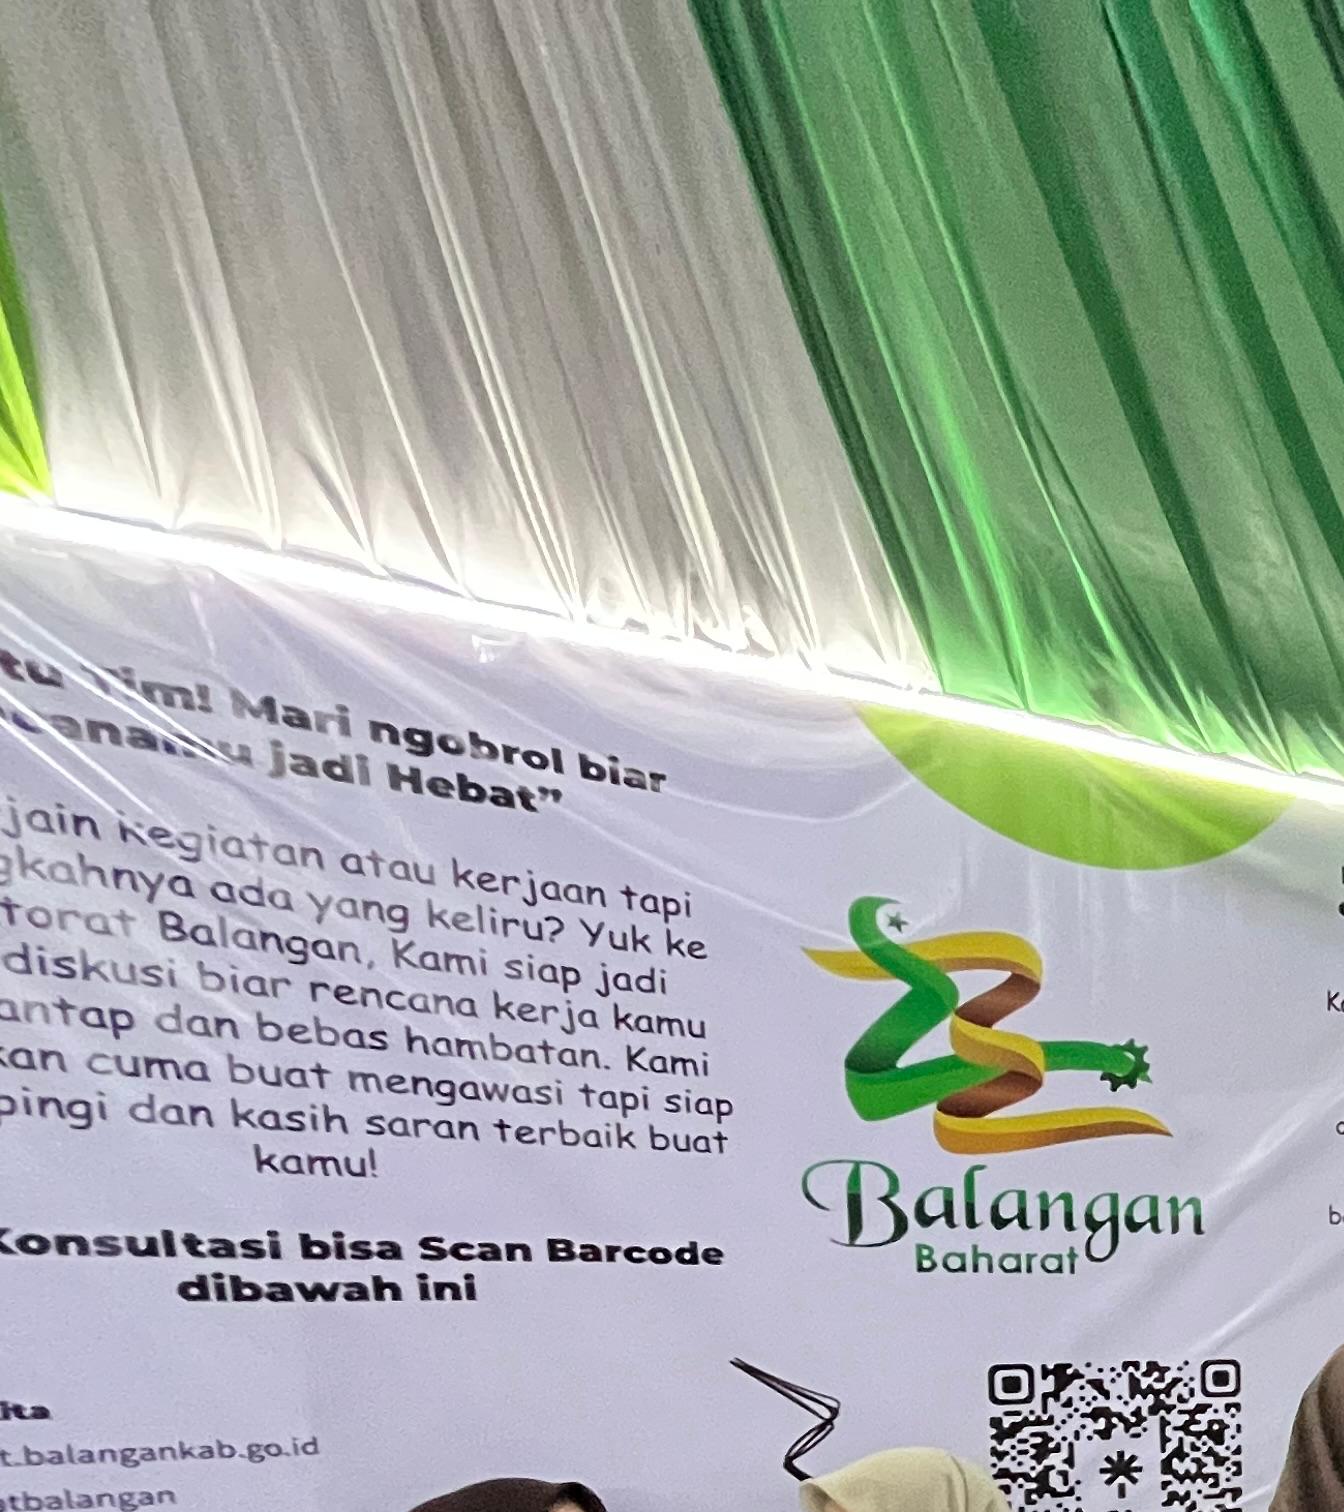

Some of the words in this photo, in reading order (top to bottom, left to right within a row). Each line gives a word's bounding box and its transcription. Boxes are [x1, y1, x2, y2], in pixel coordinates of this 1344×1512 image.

[0, 705, 253, 767] canamu
[268, 739, 371, 787] jadi
[228, 684, 353, 739] Mari
[368, 719, 565, 775] ngobrol
[578, 753, 668, 794] biar
[1, 796, 101, 840] jain
[341, 850, 434, 886] atau
[451, 859, 606, 908] kerjaan
[618, 882, 692, 923] tapi
[209, 879, 293, 912] ada
[308, 892, 410, 934] yang
[427, 896, 565, 945] keliru?
[580, 918, 652, 952] Yuk
[664, 929, 708, 961] ke
[3, 941, 177, 987] diskusi
[198, 961, 292, 999] biar
[309, 982, 479, 1019] rencana
[493, 996, 600, 1034] kerja
[612, 1006, 707, 1041] kamu
[392, 937, 488, 978] Kami
[503, 952, 582, 994] siap
[594, 960, 668, 998] jadi
[155, 1003, 240, 1041] dan
[257, 1012, 390, 1051] bebas
[405, 1026, 610, 1071] hambatan.
[626, 1044, 711, 1078] Kami
[87, 1053, 209, 1082] cuma
[228, 1055, 332, 1091] buat
[348, 1068, 564, 1106] mengawasi
[578, 1084, 651, 1117] tapi
[663, 1089, 733, 1125] siap
[129, 1094, 214, 1128] dan
[231, 1098, 348, 1137] kasih
[365, 1117, 480, 1142] saran
[494, 1119, 636, 1152] terbaik
[648, 1125, 729, 1155] buat
[253, 1144, 379, 1178] kamu!
[801, 1160, 1206, 1261] Balangan
[299, 1231, 402, 1260] bisa
[418, 1235, 533, 1262] Scan
[547, 1237, 724, 1267] Barcode
[916, 1244, 1078, 1274] Baharat
[177, 1272, 401, 1302] dibawah
[417, 1271, 478, 1301] ini
